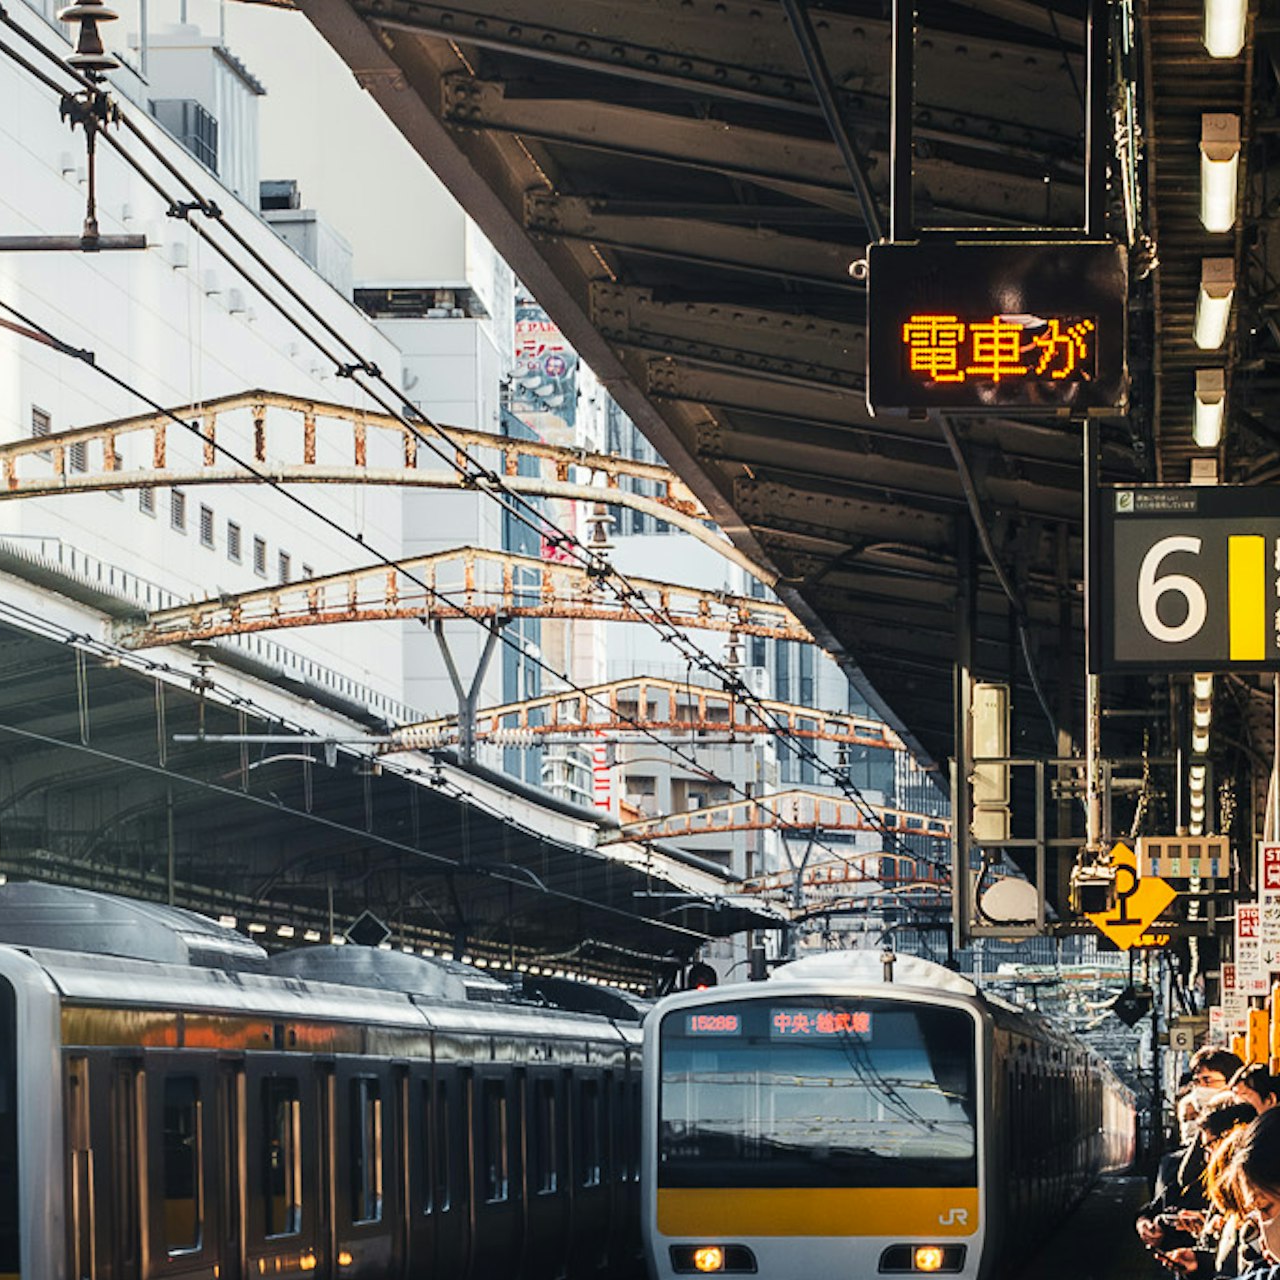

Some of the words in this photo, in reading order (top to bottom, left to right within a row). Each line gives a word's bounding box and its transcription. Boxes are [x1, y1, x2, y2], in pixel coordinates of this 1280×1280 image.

[903, 316, 1095, 382] 電車が
[1138, 535, 1208, 643] 6
[1177, 1032, 1187, 1046] 6
[938, 1207, 968, 1226] JR
